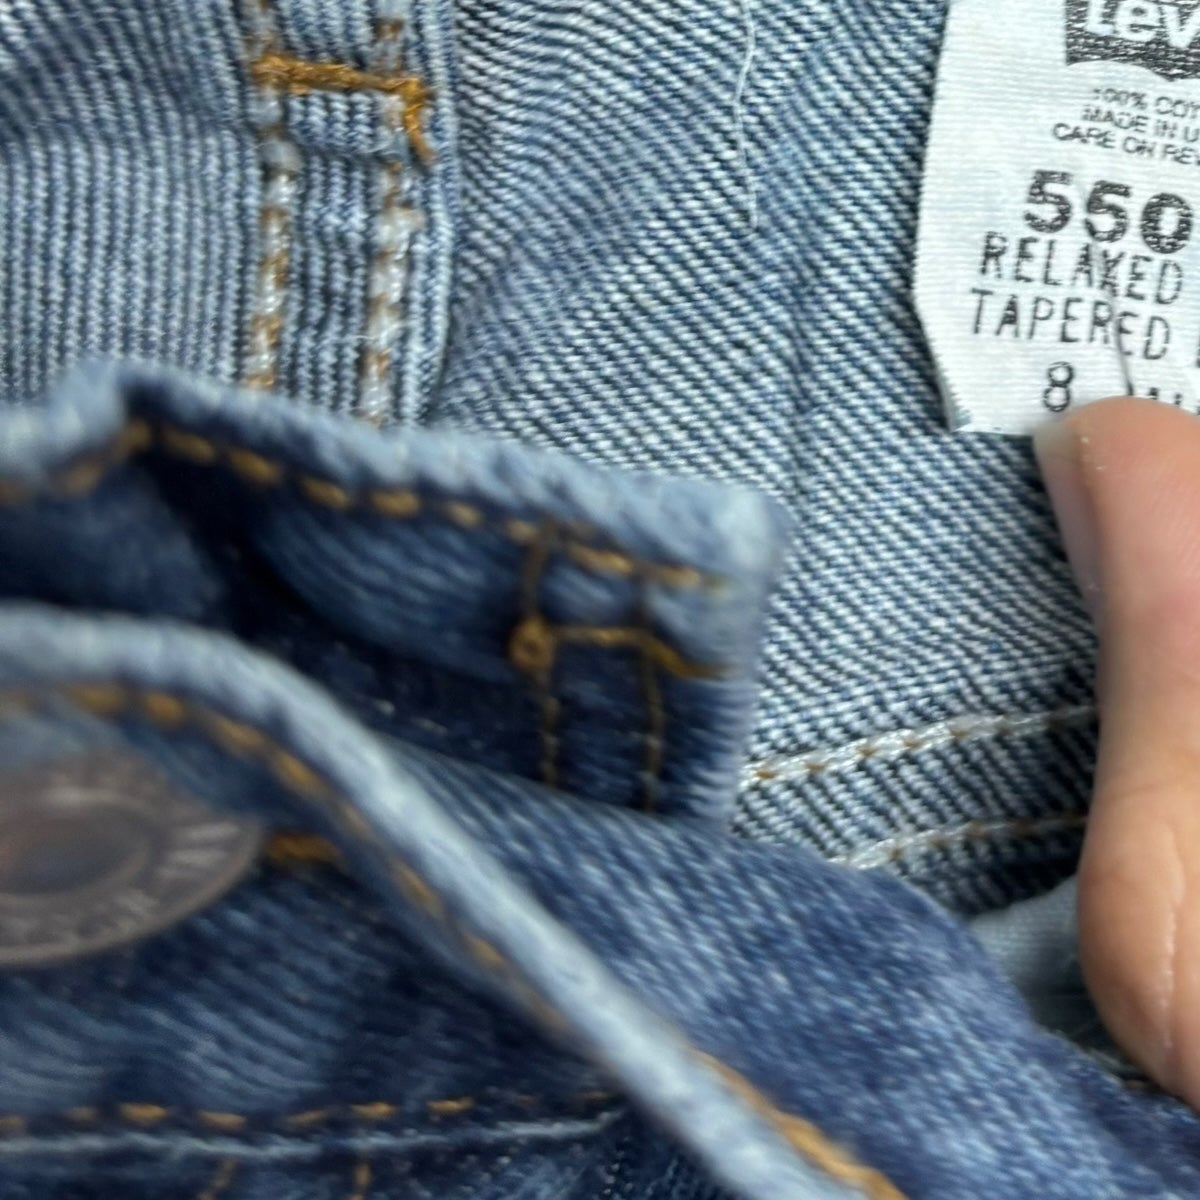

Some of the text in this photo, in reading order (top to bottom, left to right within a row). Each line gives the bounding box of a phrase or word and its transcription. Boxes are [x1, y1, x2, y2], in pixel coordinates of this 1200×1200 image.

[1053, 122, 1116, 150] CARE
[1122, 134, 1158, 158] ON
[1083, 106, 1146, 133] MADE
[1153, 117, 1178, 139] IN
[1023, 169, 1193, 254] 550
[981, 230, 1184, 305] RELAXED
[970, 288, 1171, 361] TAPERED
[1042, 361, 1074, 413] 8
